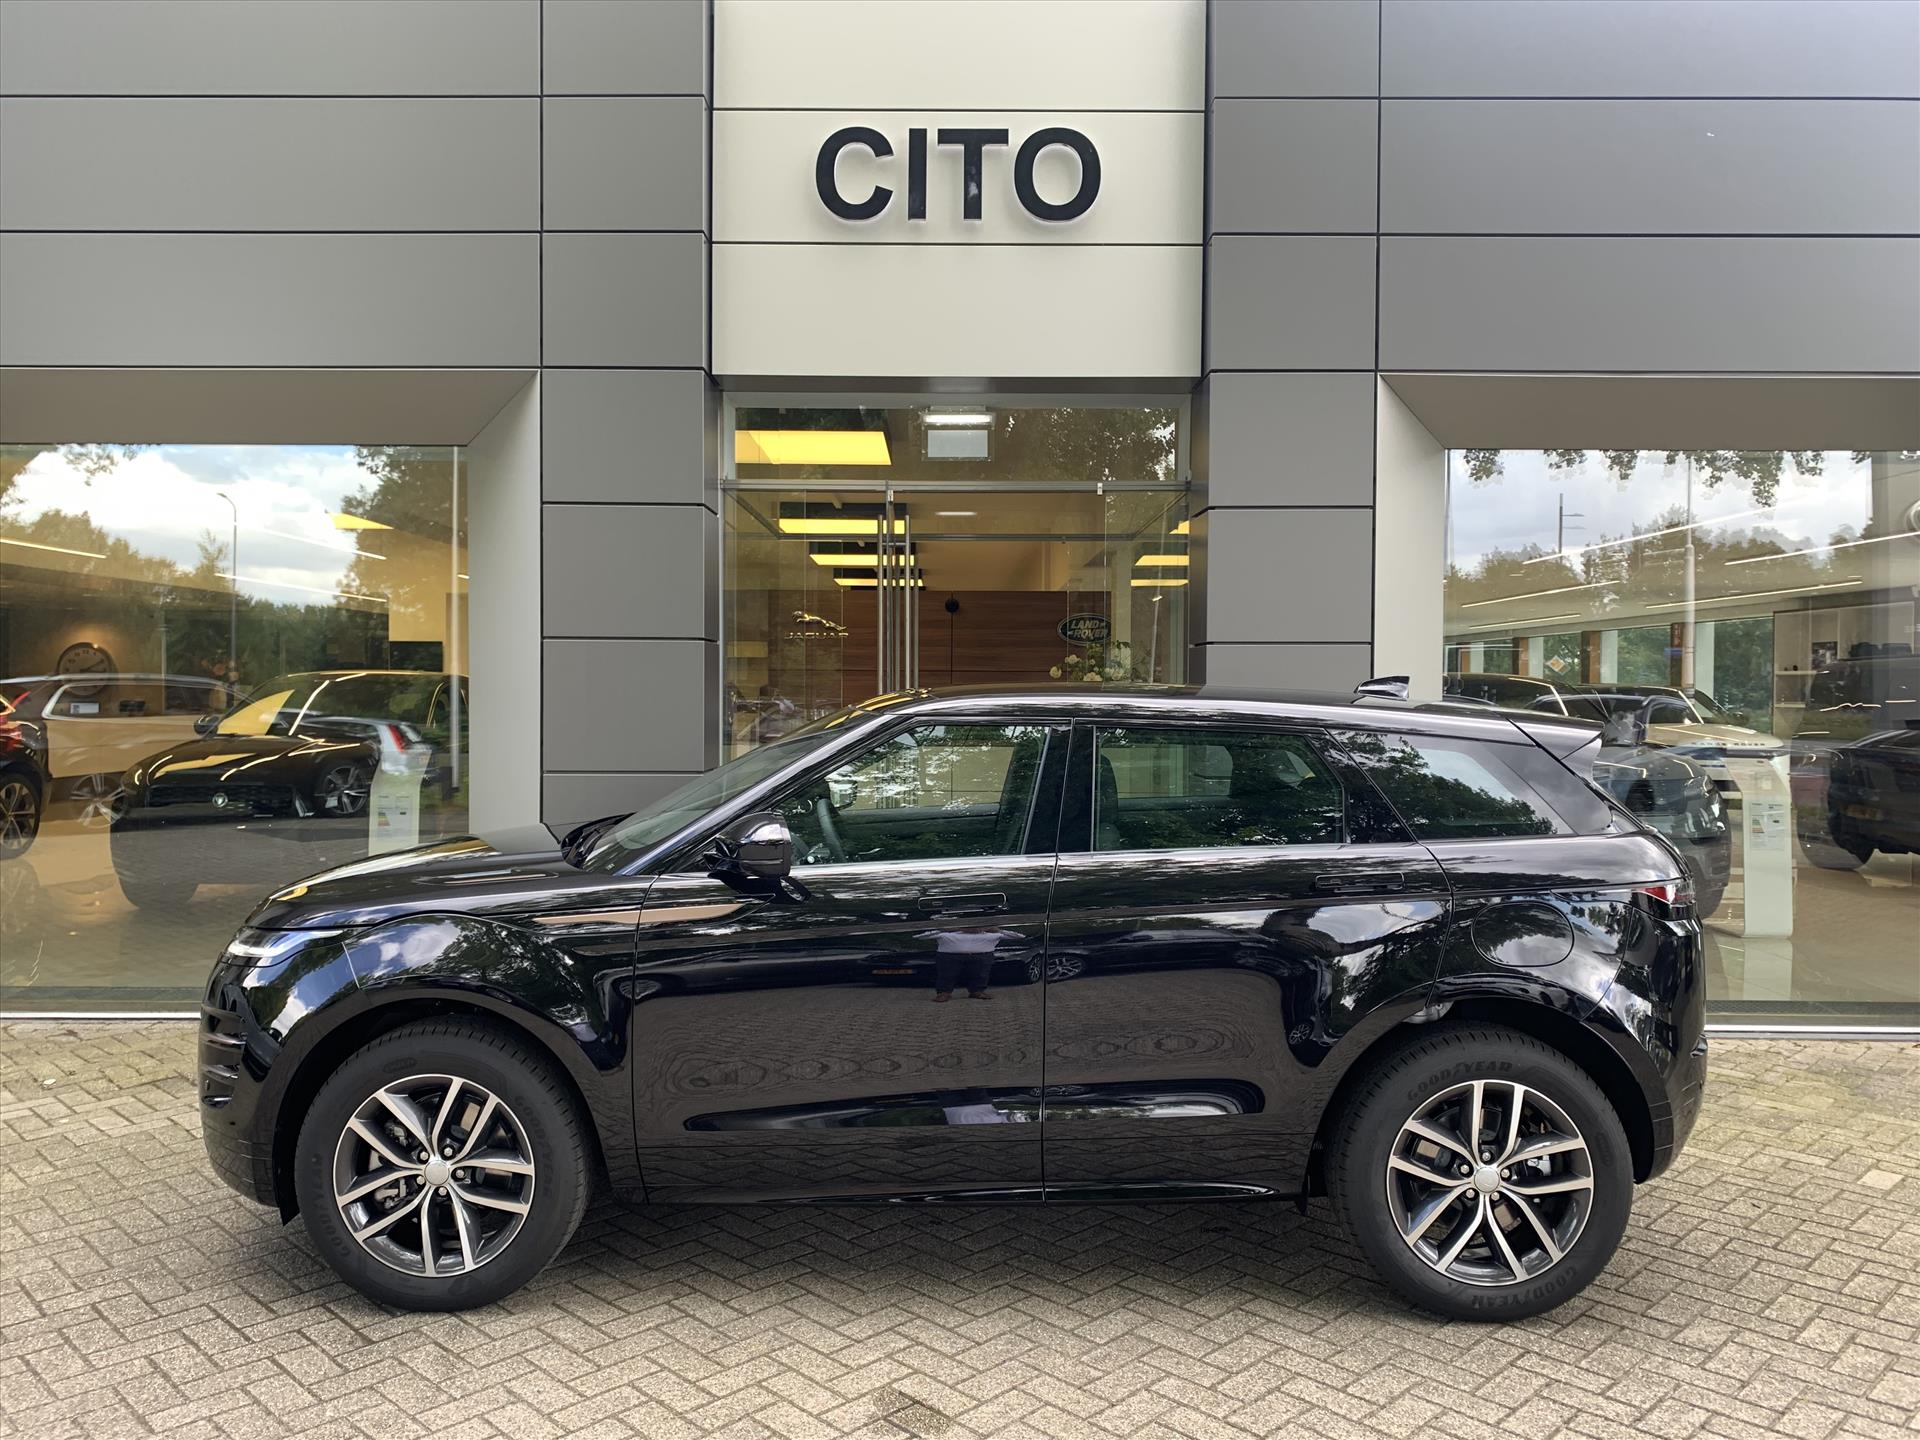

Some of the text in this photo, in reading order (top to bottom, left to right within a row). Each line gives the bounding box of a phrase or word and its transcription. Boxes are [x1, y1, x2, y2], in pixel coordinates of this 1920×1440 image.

[815, 126, 1101, 221] CITO
[1071, 620, 1100, 629] LAND
[1074, 629, 1109, 639] ROVER
[1407, 1060, 1513, 1102] GOODYEAR
